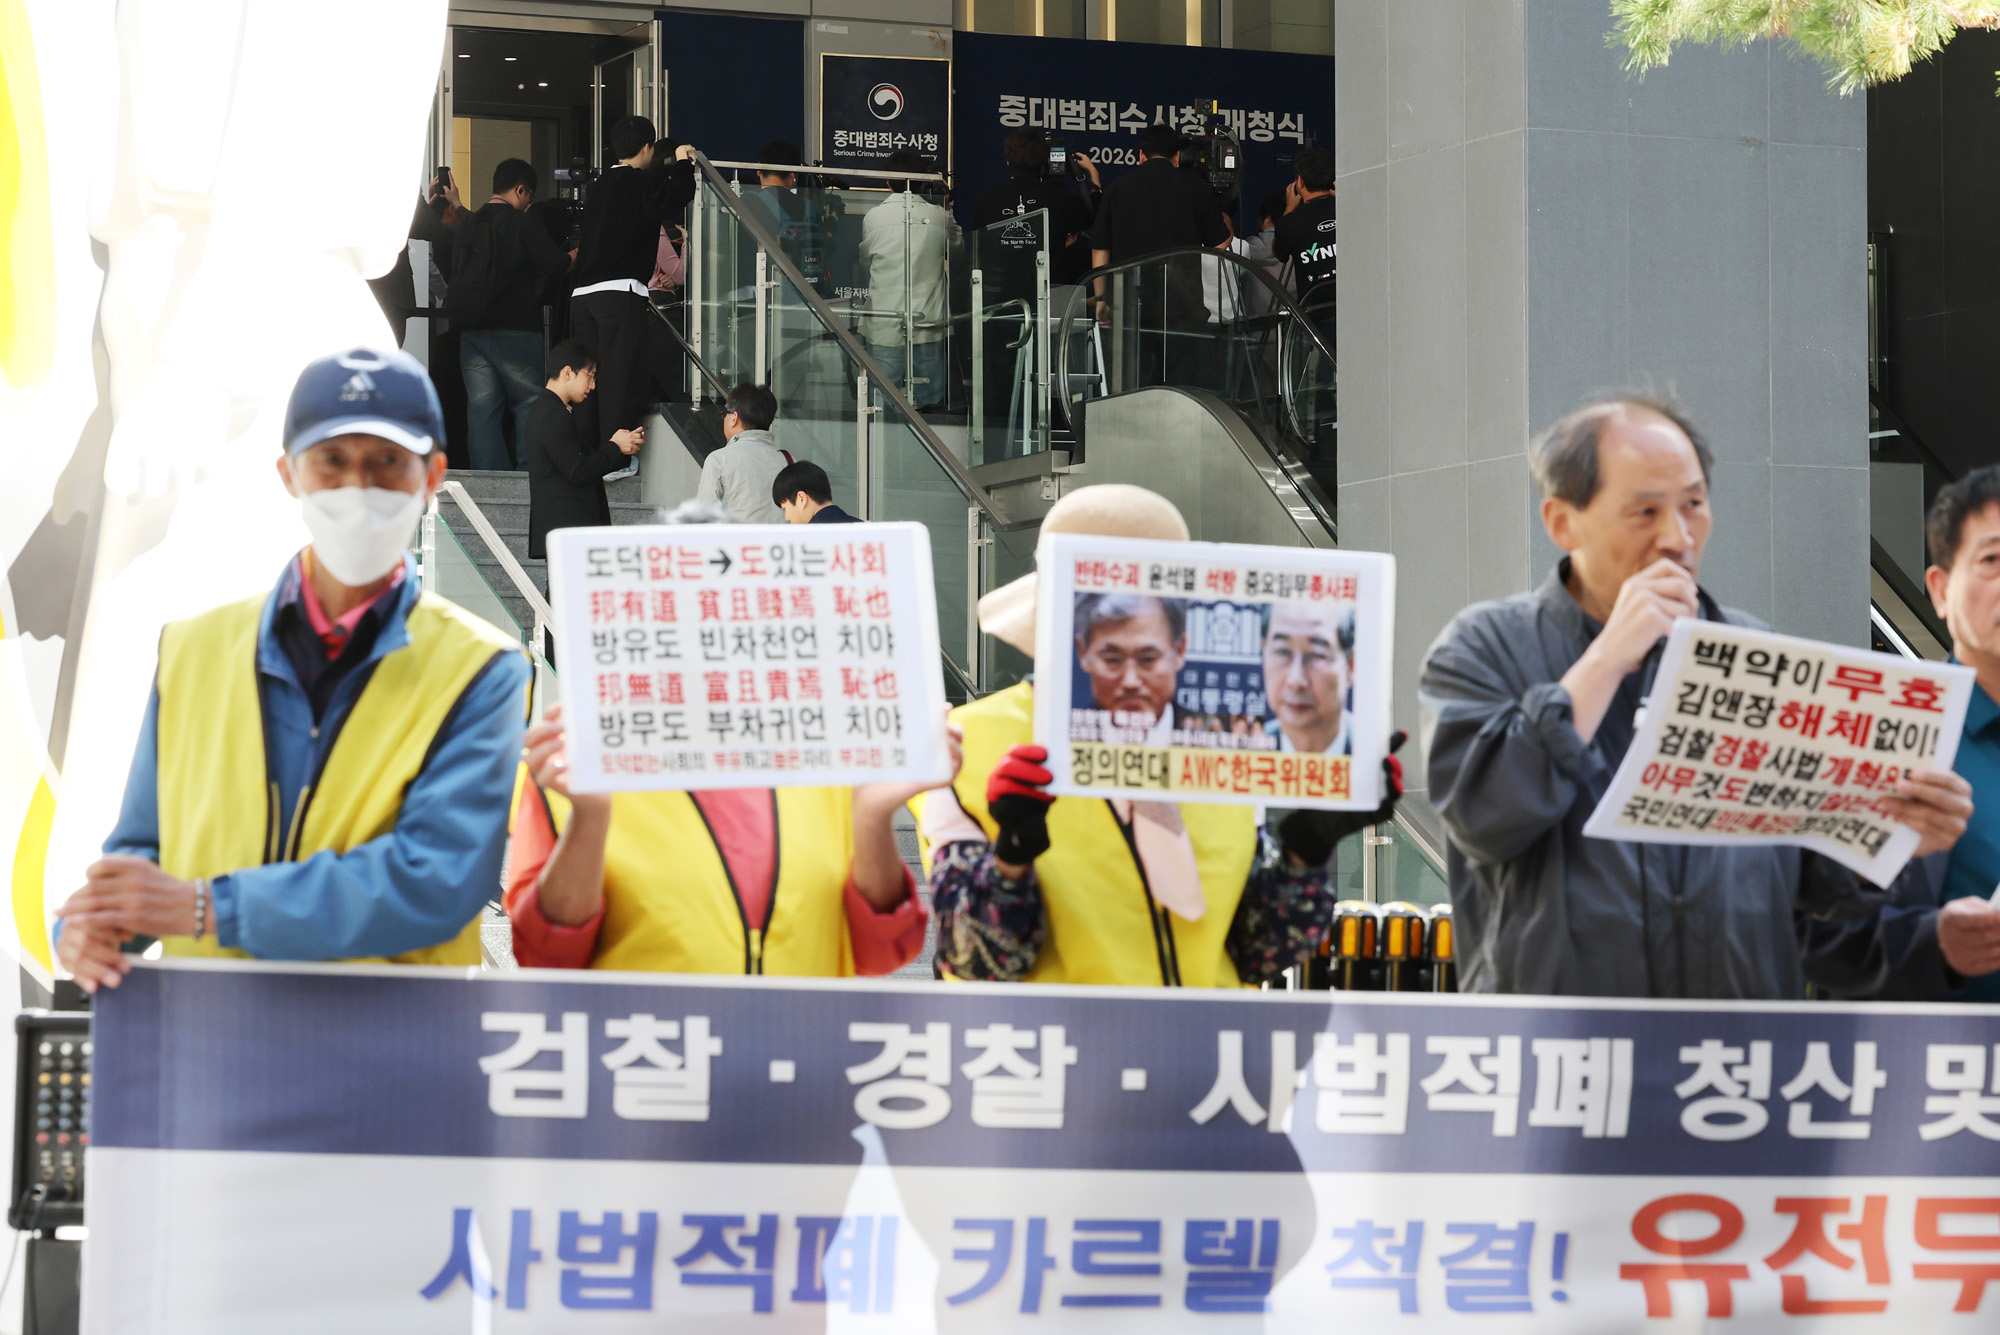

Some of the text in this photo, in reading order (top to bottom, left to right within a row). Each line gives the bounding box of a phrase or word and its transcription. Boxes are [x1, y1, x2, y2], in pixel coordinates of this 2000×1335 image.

[833, 129, 938, 151] 중대범죄수사청
[833, 149, 856, 157] Serious
[857, 150, 875, 158] Crime
[587, 544, 704, 581] 도덕없는
[1149, 563, 1196, 591] 윤석열
[1206, 569, 1237, 596] 석방
[592, 624, 895, 666] 방유도 빈차천언 치야
[600, 705, 902, 748] 방무도 부차귀언 치야
[1071, 747, 1170, 789] 정의연대
[477, 1011, 2000, 1143] 검찰 경찰 사법적폐 청산 및
[419, 1207, 899, 1315] 사법적폐
[946, 1215, 1281, 1315] 카르텔
[1323, 1219, 1571, 1316] 척결!
